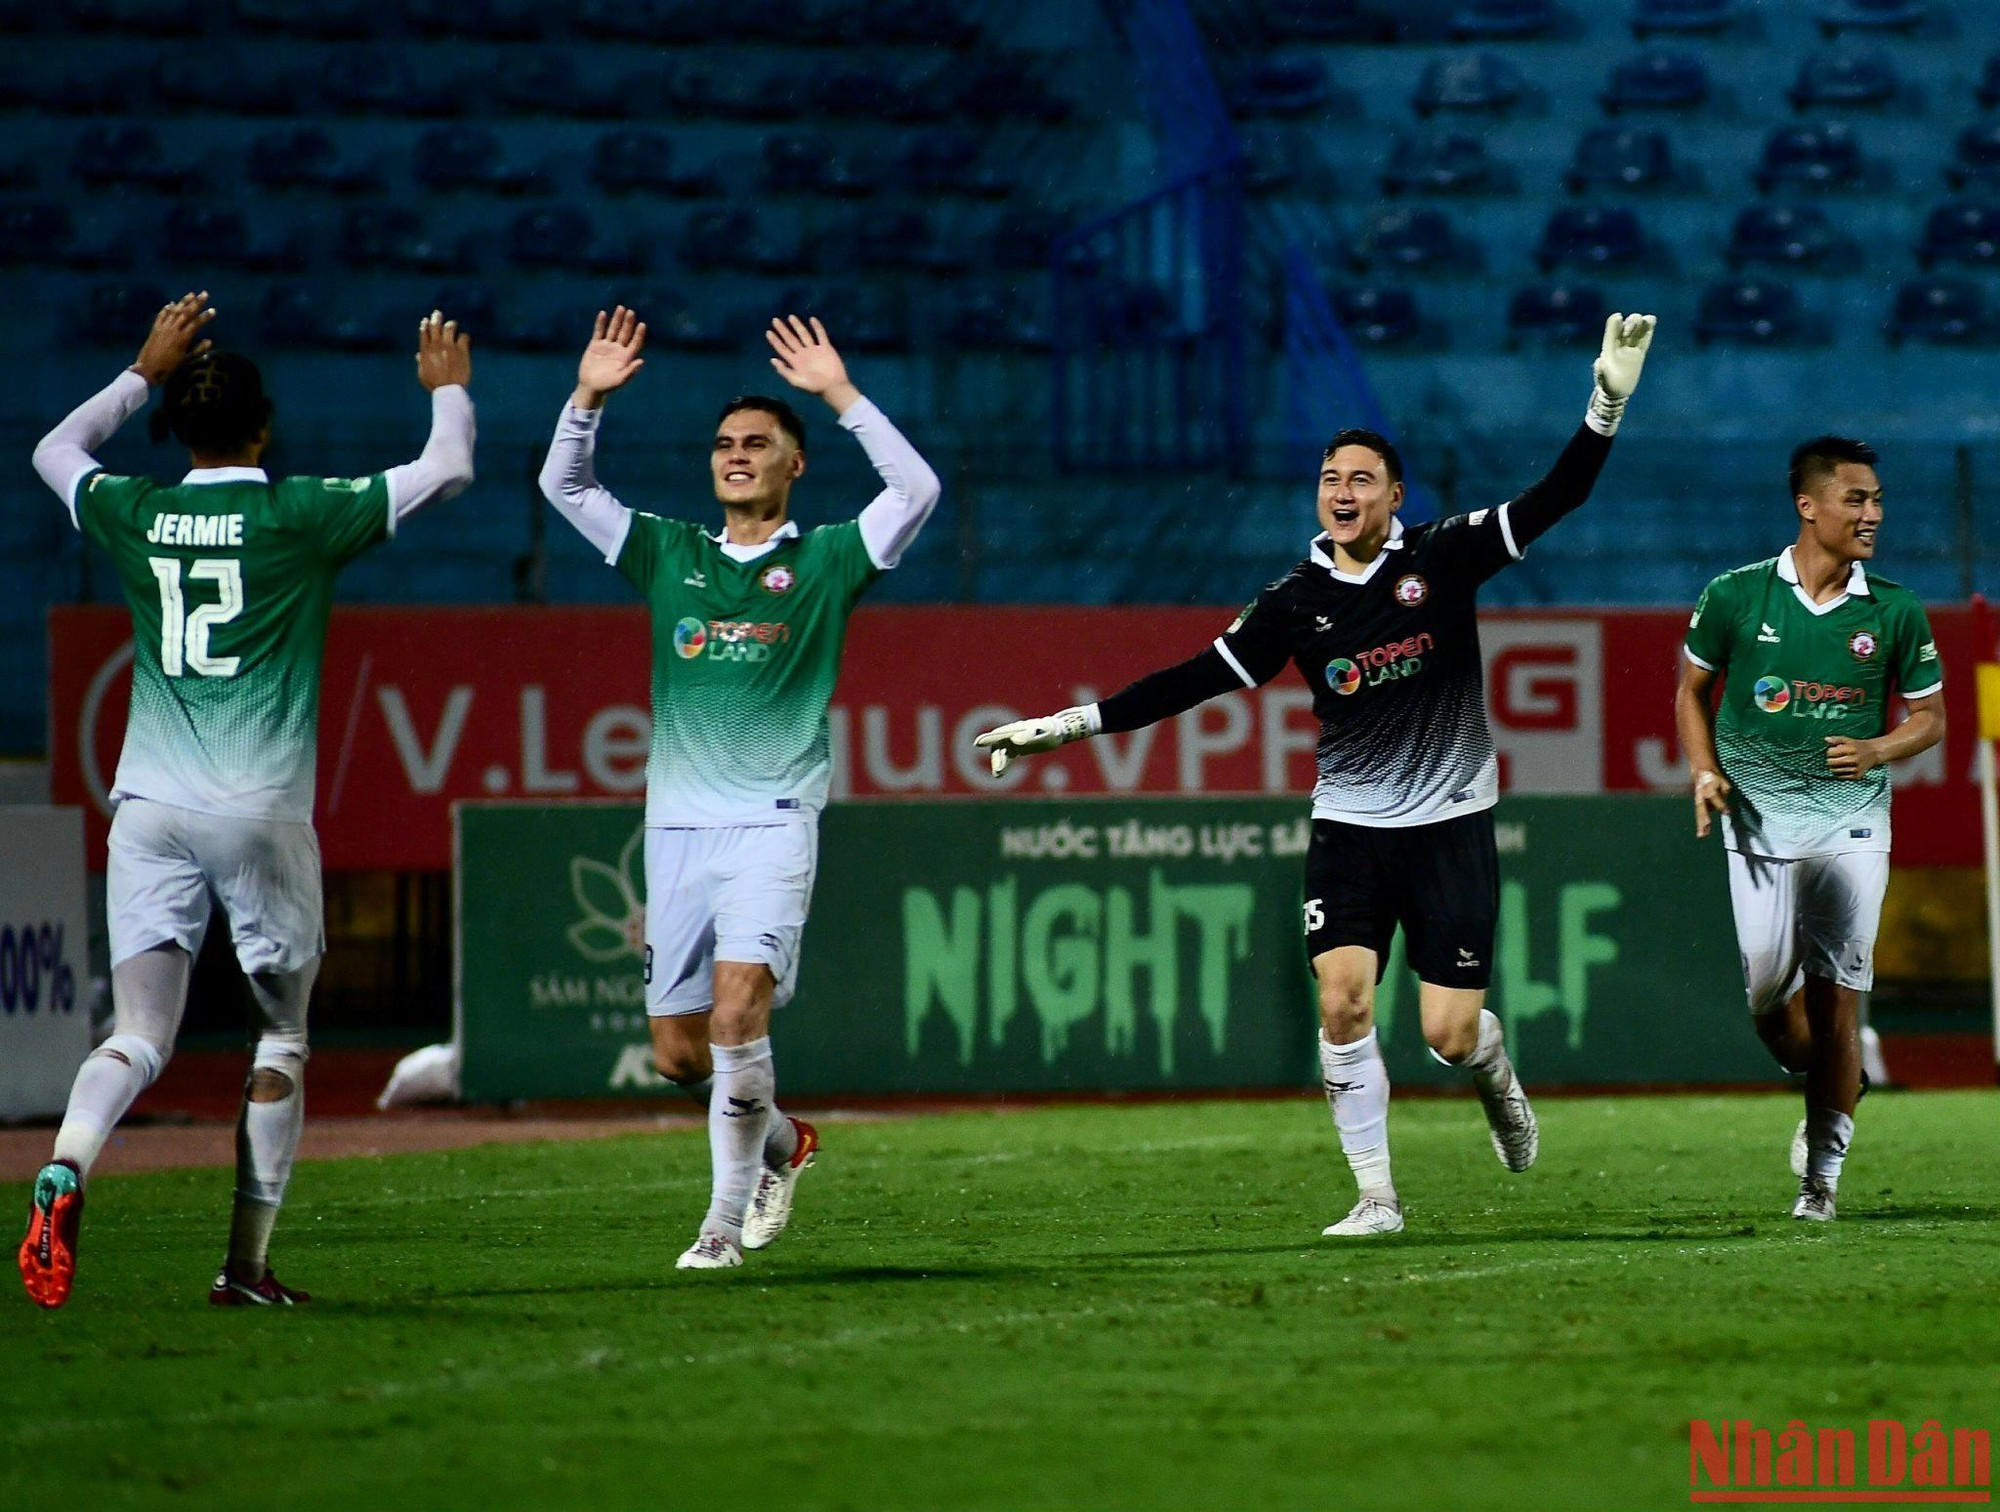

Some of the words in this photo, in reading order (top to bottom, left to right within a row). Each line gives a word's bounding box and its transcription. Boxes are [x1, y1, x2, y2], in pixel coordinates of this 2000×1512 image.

[147, 513, 243, 546] JERMIE
[149, 557, 243, 677] 12
[1365, 657, 1422, 687] LAND
[905, 868, 1254, 1074] NIGHT
